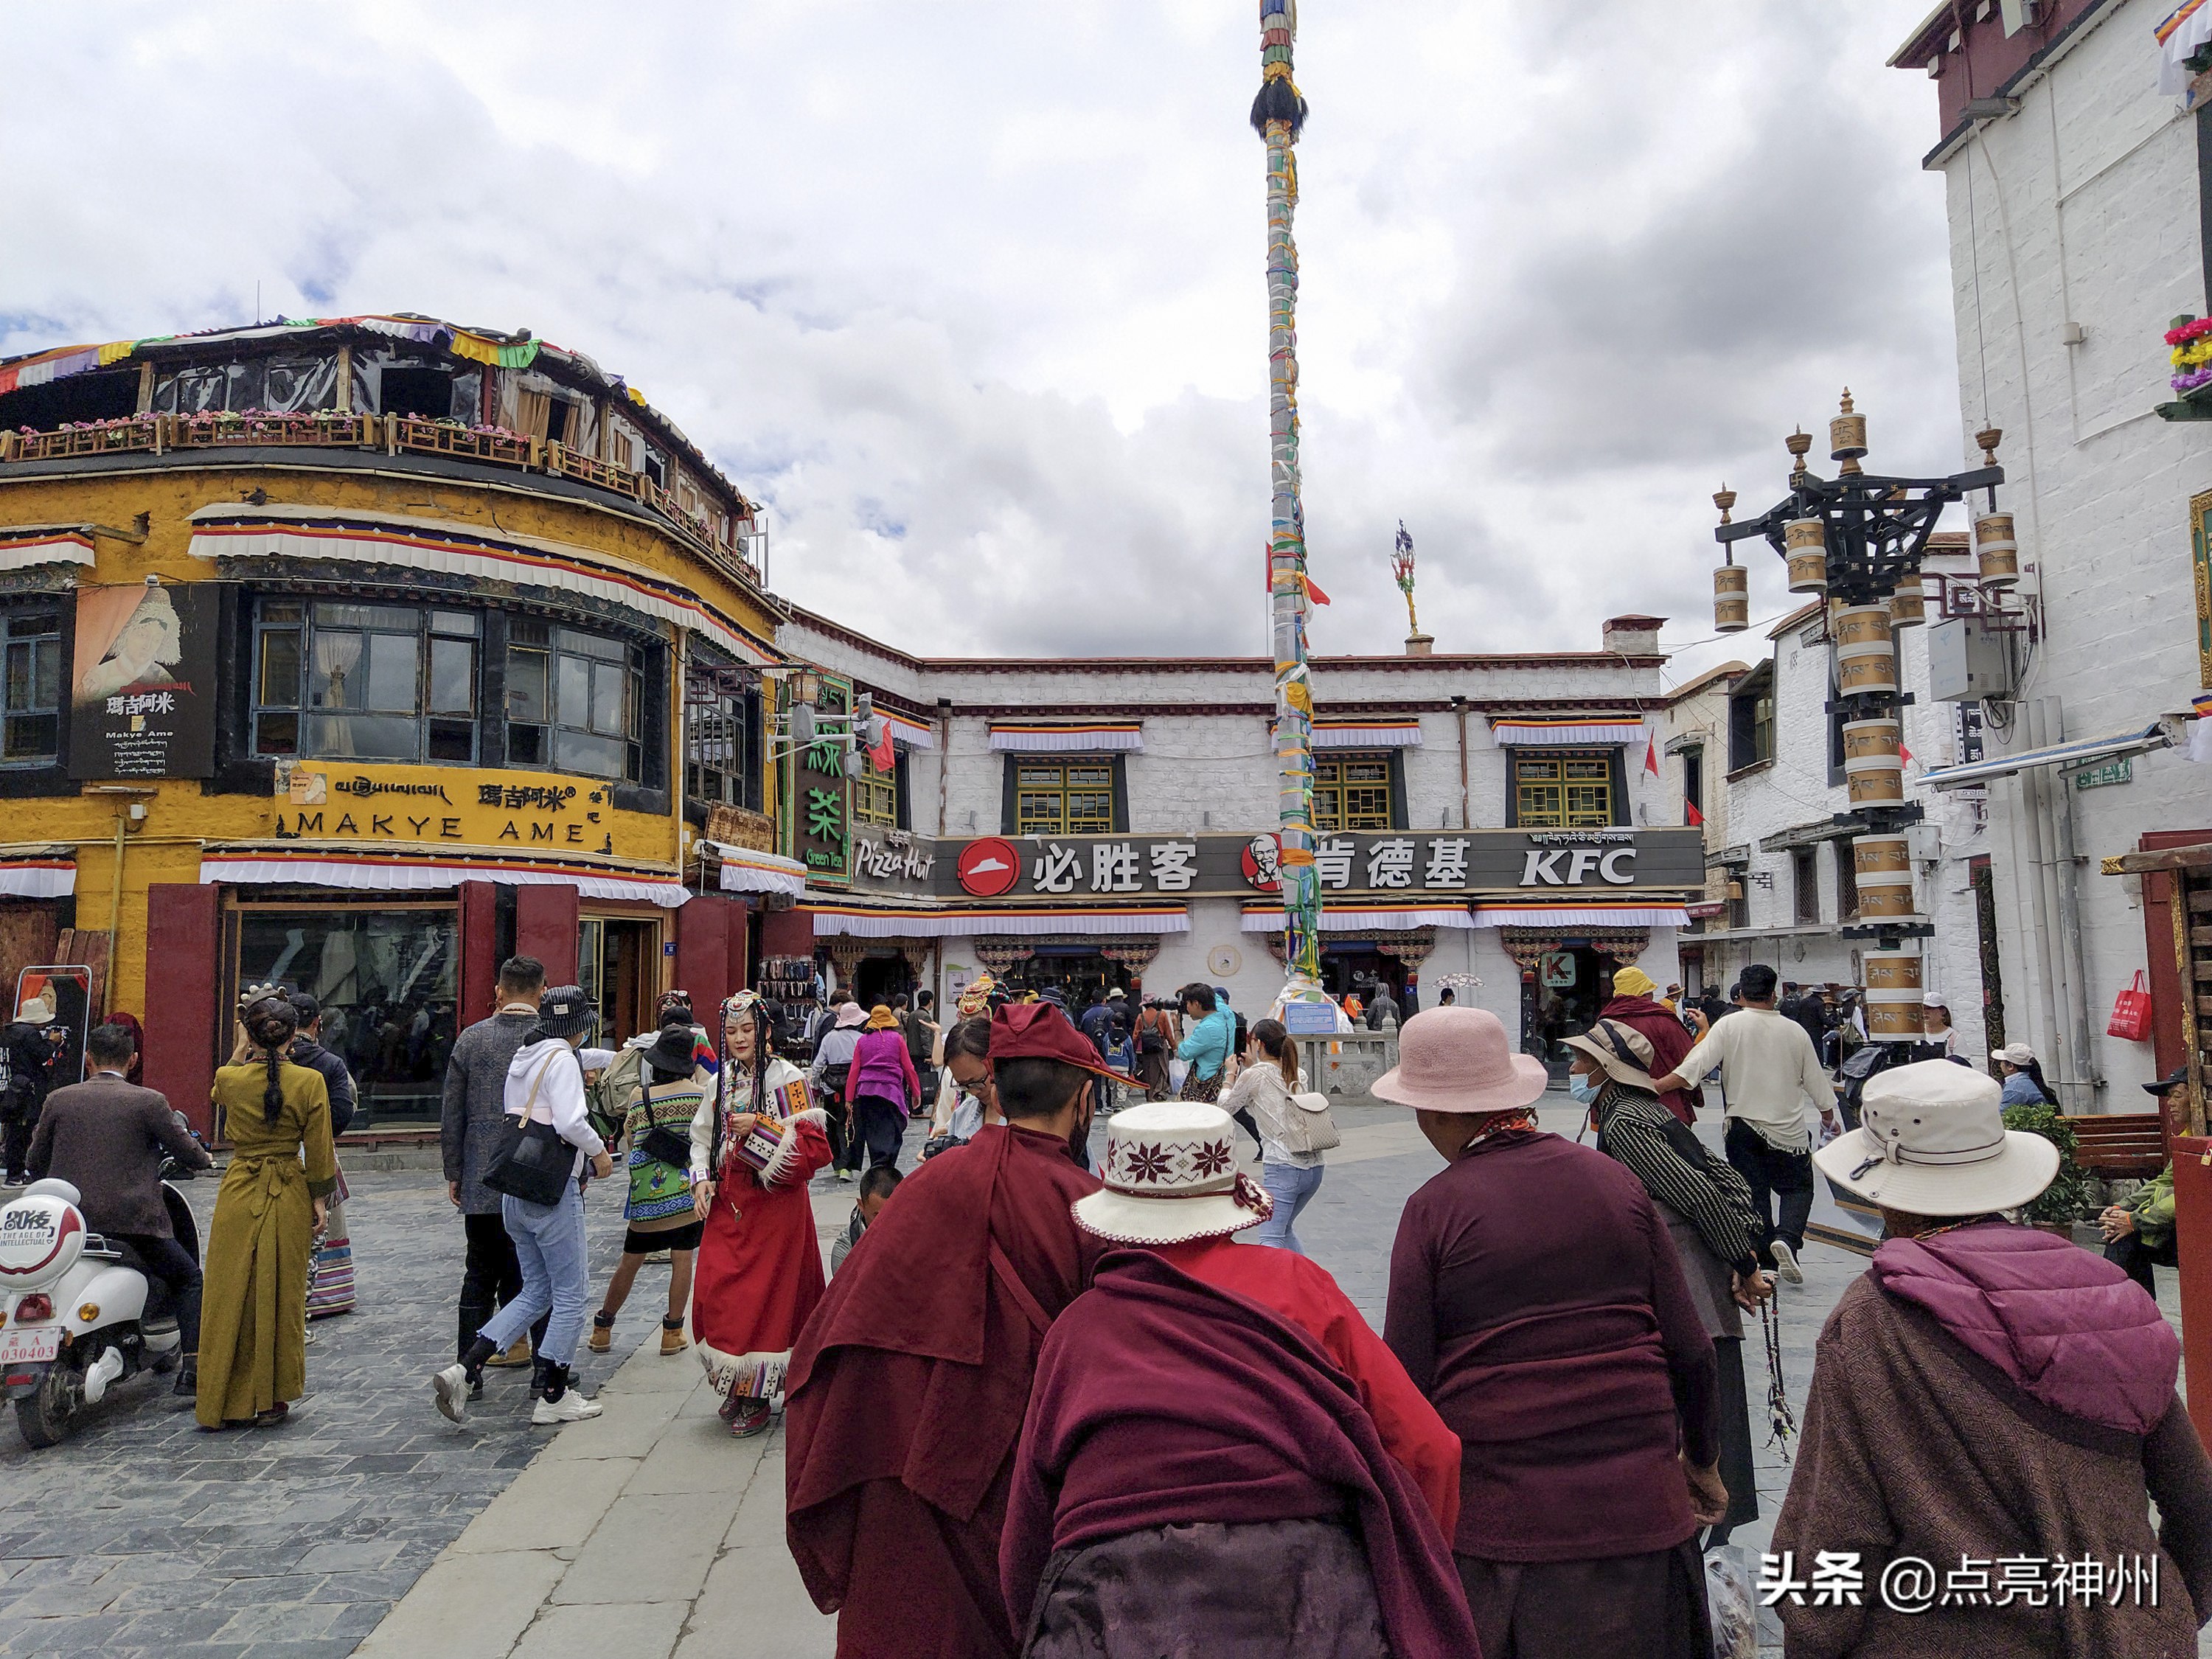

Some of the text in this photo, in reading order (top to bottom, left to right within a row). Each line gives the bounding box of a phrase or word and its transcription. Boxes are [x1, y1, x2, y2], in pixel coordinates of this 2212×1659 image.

[106, 692, 175, 715] 瑪吉阿米
[298, 812, 584, 842] MAKYE AME
[806, 848, 843, 869] Green Tea
[855, 838, 902, 878] Pizza
[903, 846, 936, 881] Hut
[1032, 841, 1199, 893] 必胜客
[1314, 838, 1470, 889] 肯德基
[1520, 848, 1637, 886] KFC
[0, 1239, 46, 1247] INTELLECTUAL
[1, 1346, 54, 1361] 030403
[31, 1335, 41, 1346] A
